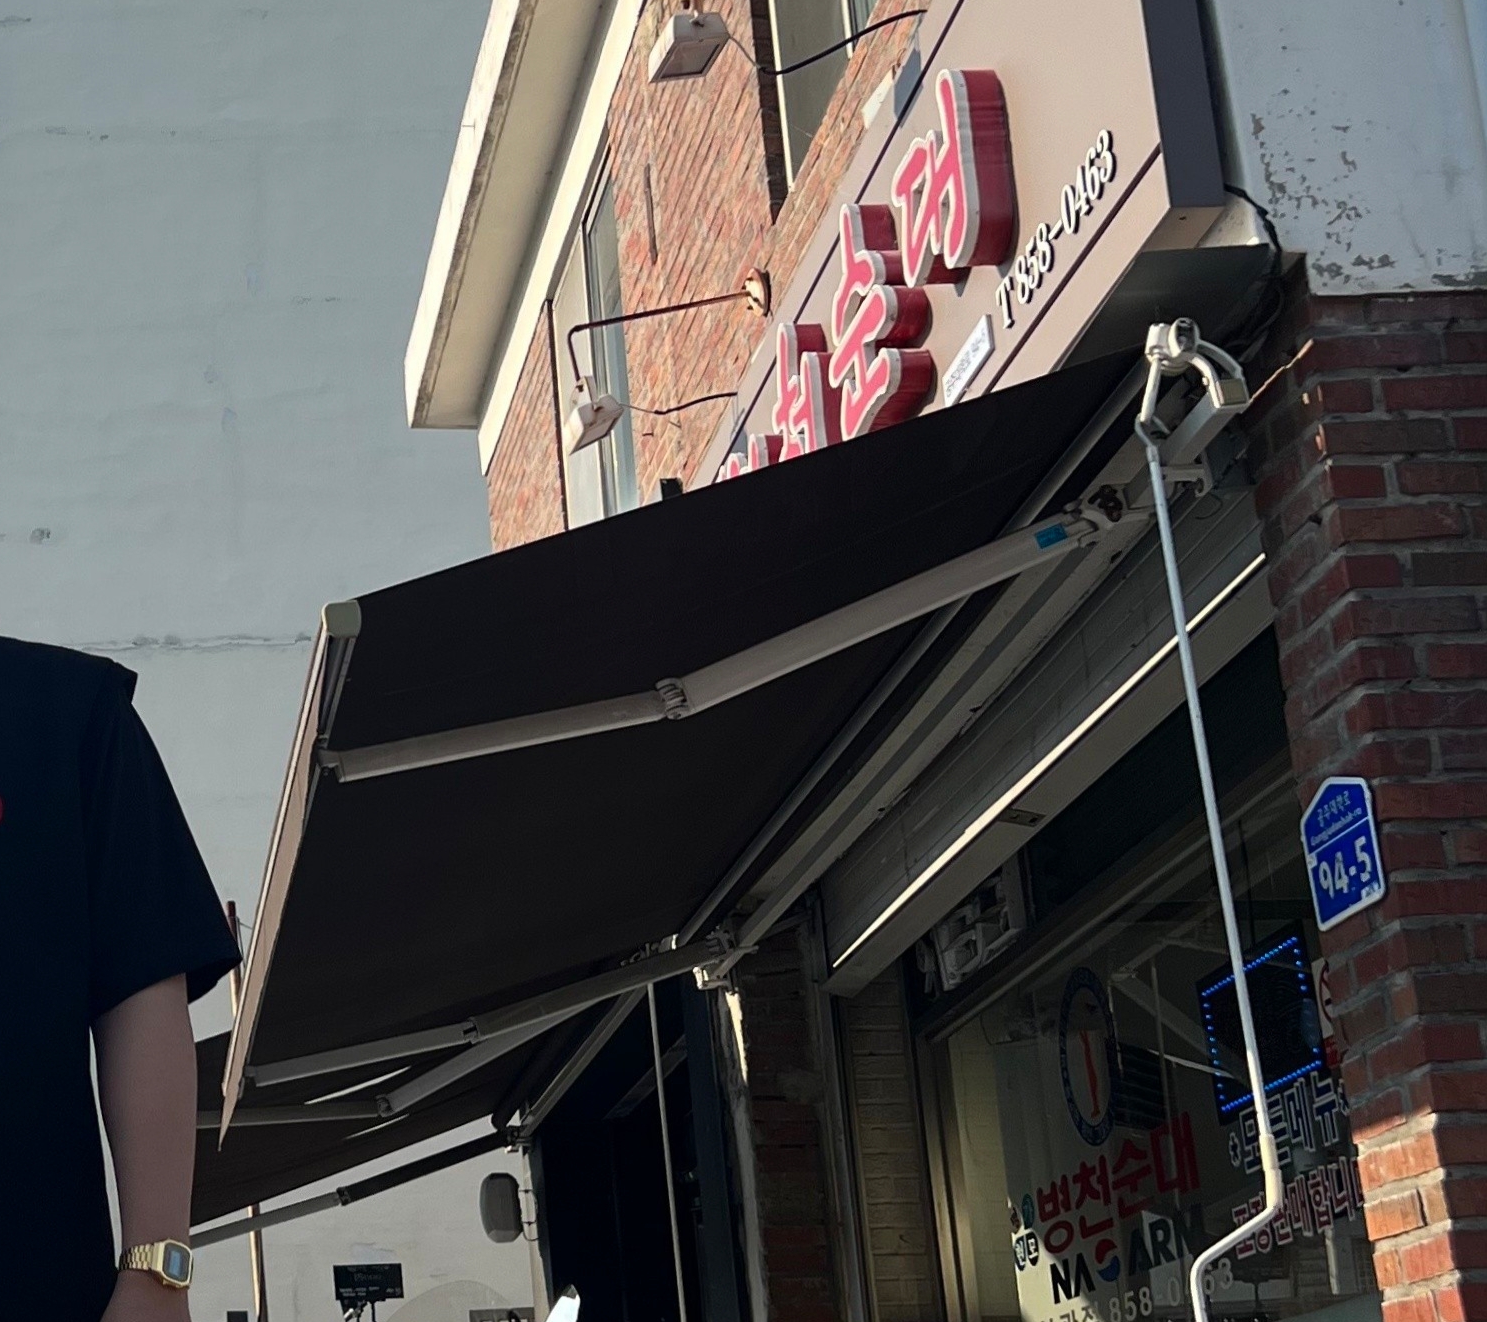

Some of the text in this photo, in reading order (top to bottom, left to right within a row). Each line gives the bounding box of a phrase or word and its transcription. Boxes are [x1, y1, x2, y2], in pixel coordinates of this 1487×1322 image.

[995, 129, 1116, 330] T 858-0463
[1318, 835, 1372, 899] 94-5
[1037, 1112, 1200, 1254] 병천순대
